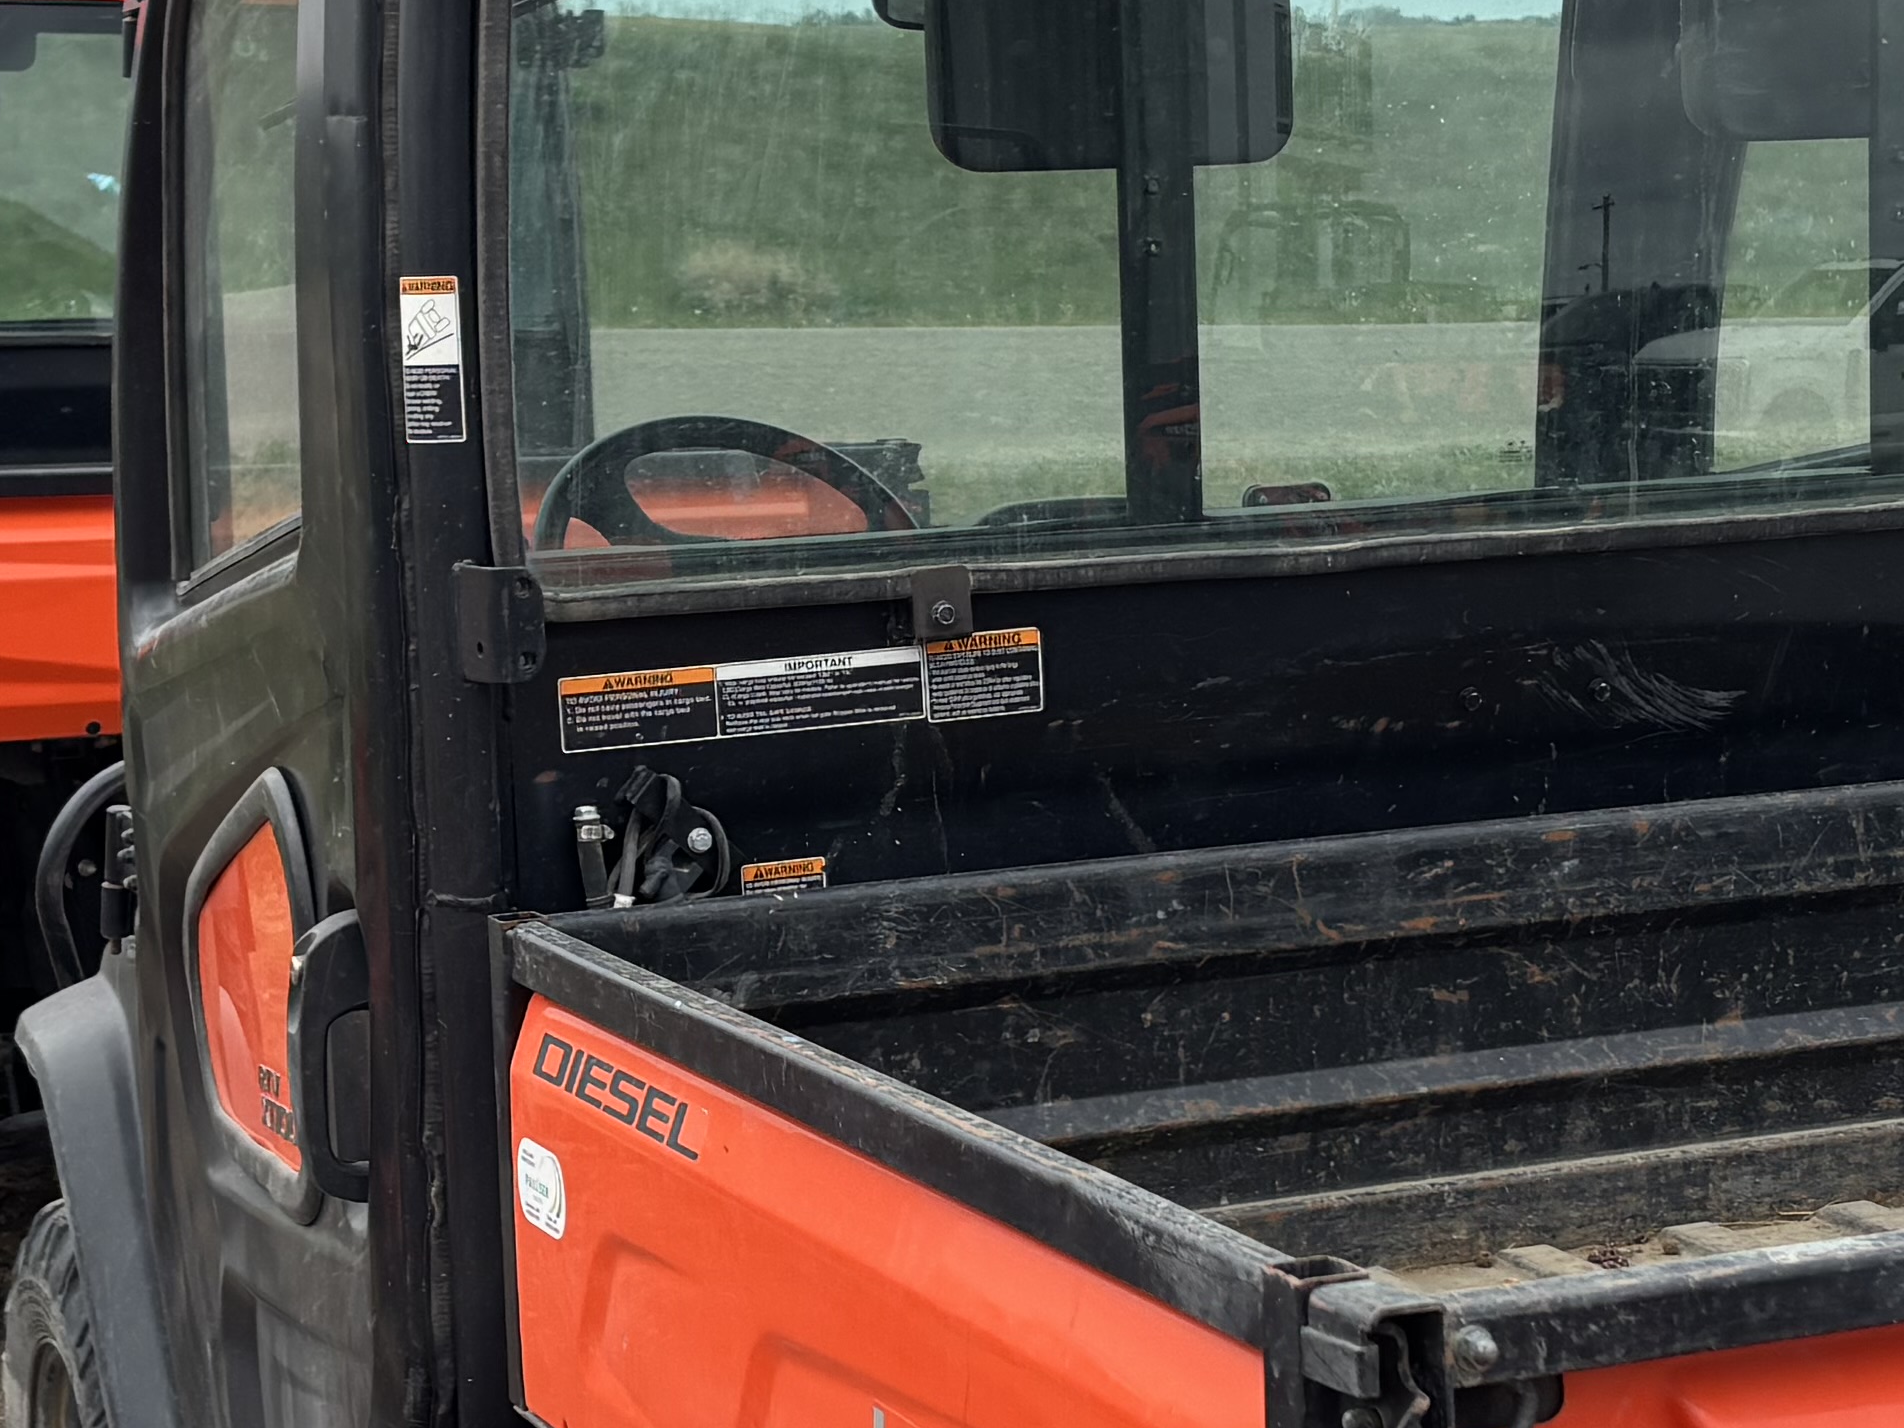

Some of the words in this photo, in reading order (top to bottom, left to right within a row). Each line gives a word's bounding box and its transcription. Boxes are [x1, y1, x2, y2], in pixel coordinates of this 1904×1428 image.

[955, 632, 1023, 650] WARNING
[784, 656, 854, 672] IMPORTANT
[614, 673, 674, 689] WARNING
[764, 862, 814, 878] WARNING
[531, 1031, 701, 1162] DIESEL
